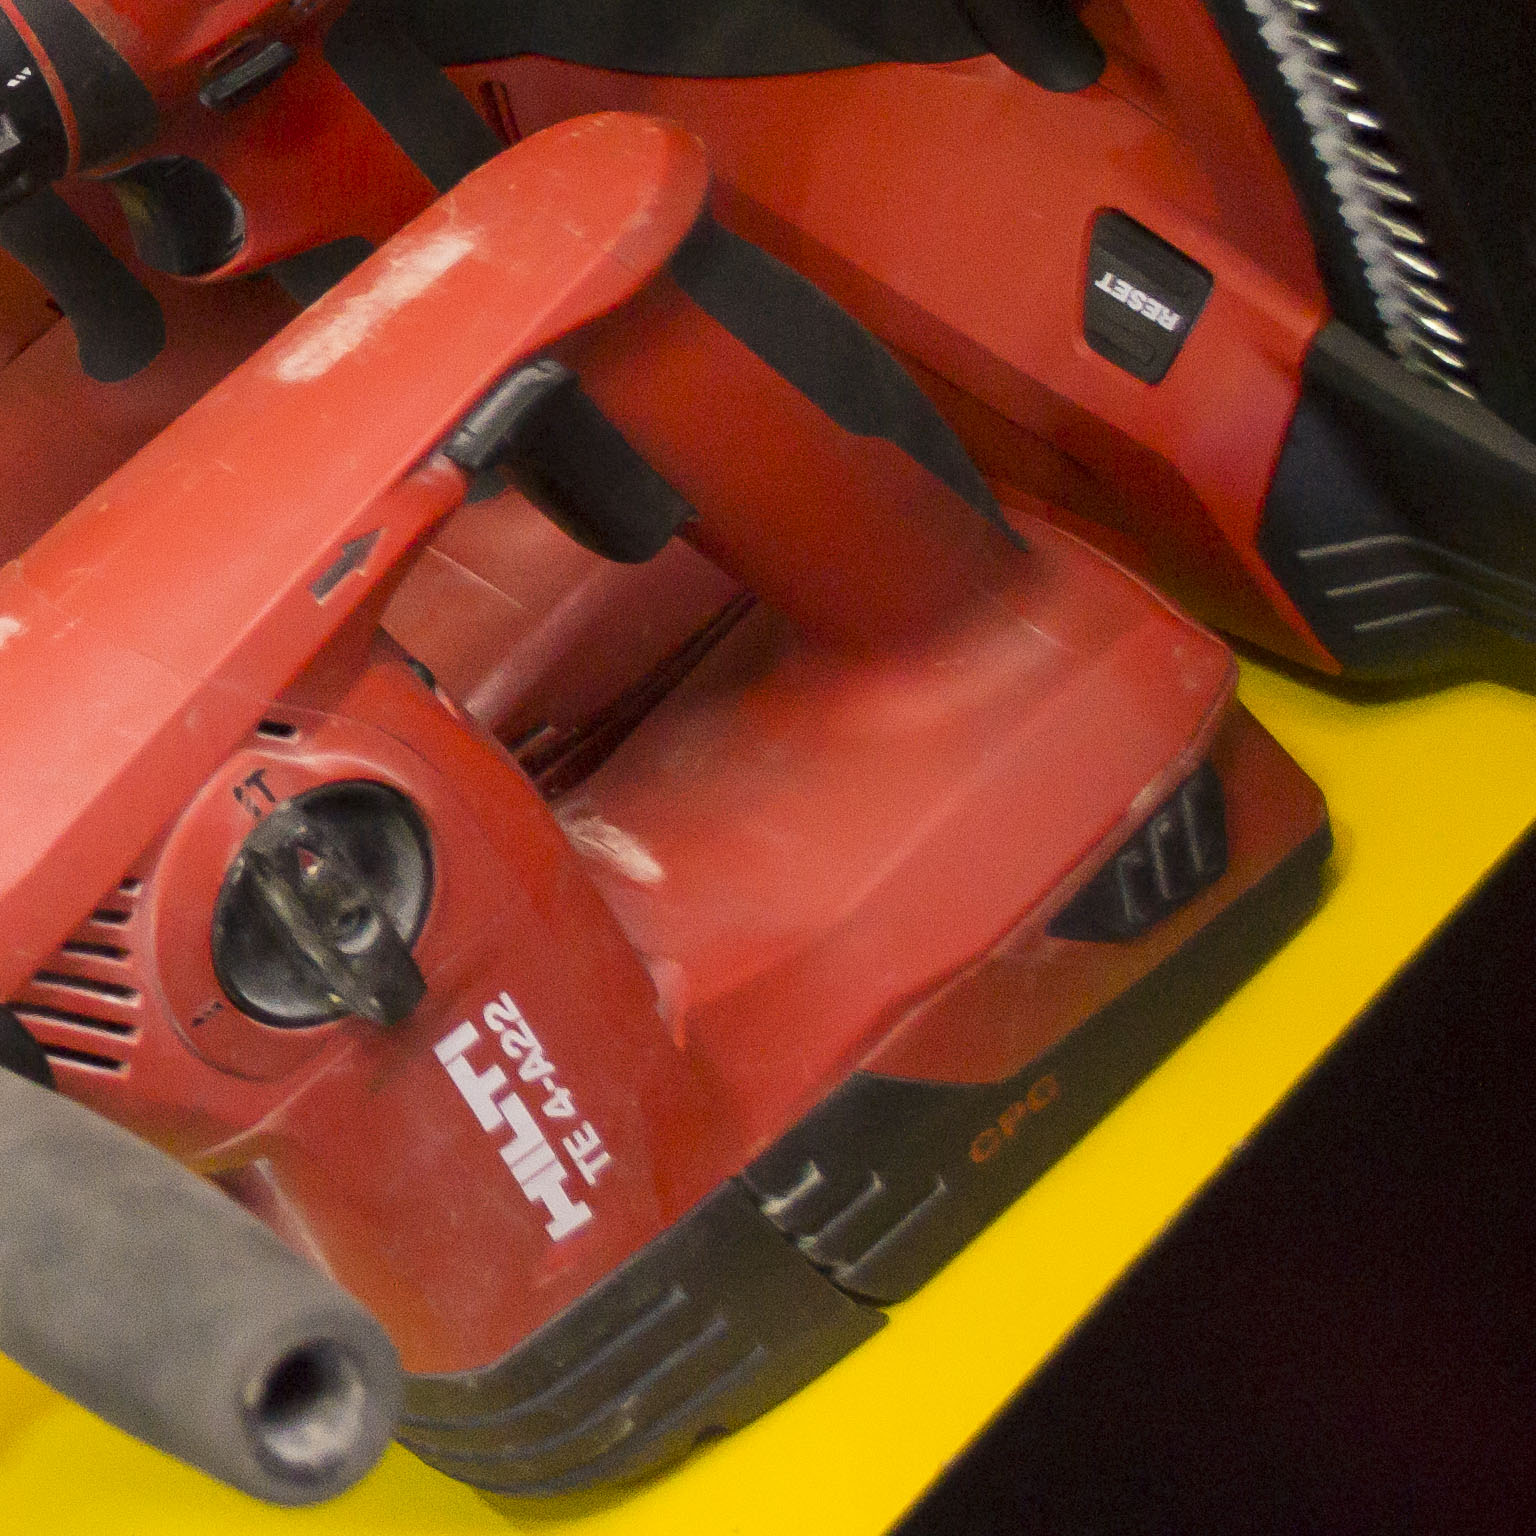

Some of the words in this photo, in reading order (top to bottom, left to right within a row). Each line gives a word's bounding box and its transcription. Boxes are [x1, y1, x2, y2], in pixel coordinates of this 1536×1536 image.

[1094, 272, 1181, 332] RESET
[482, 990, 577, 1119] 4-A22
[432, 1020, 594, 1243] HILTI
[562, 1119, 613, 1187] TE
